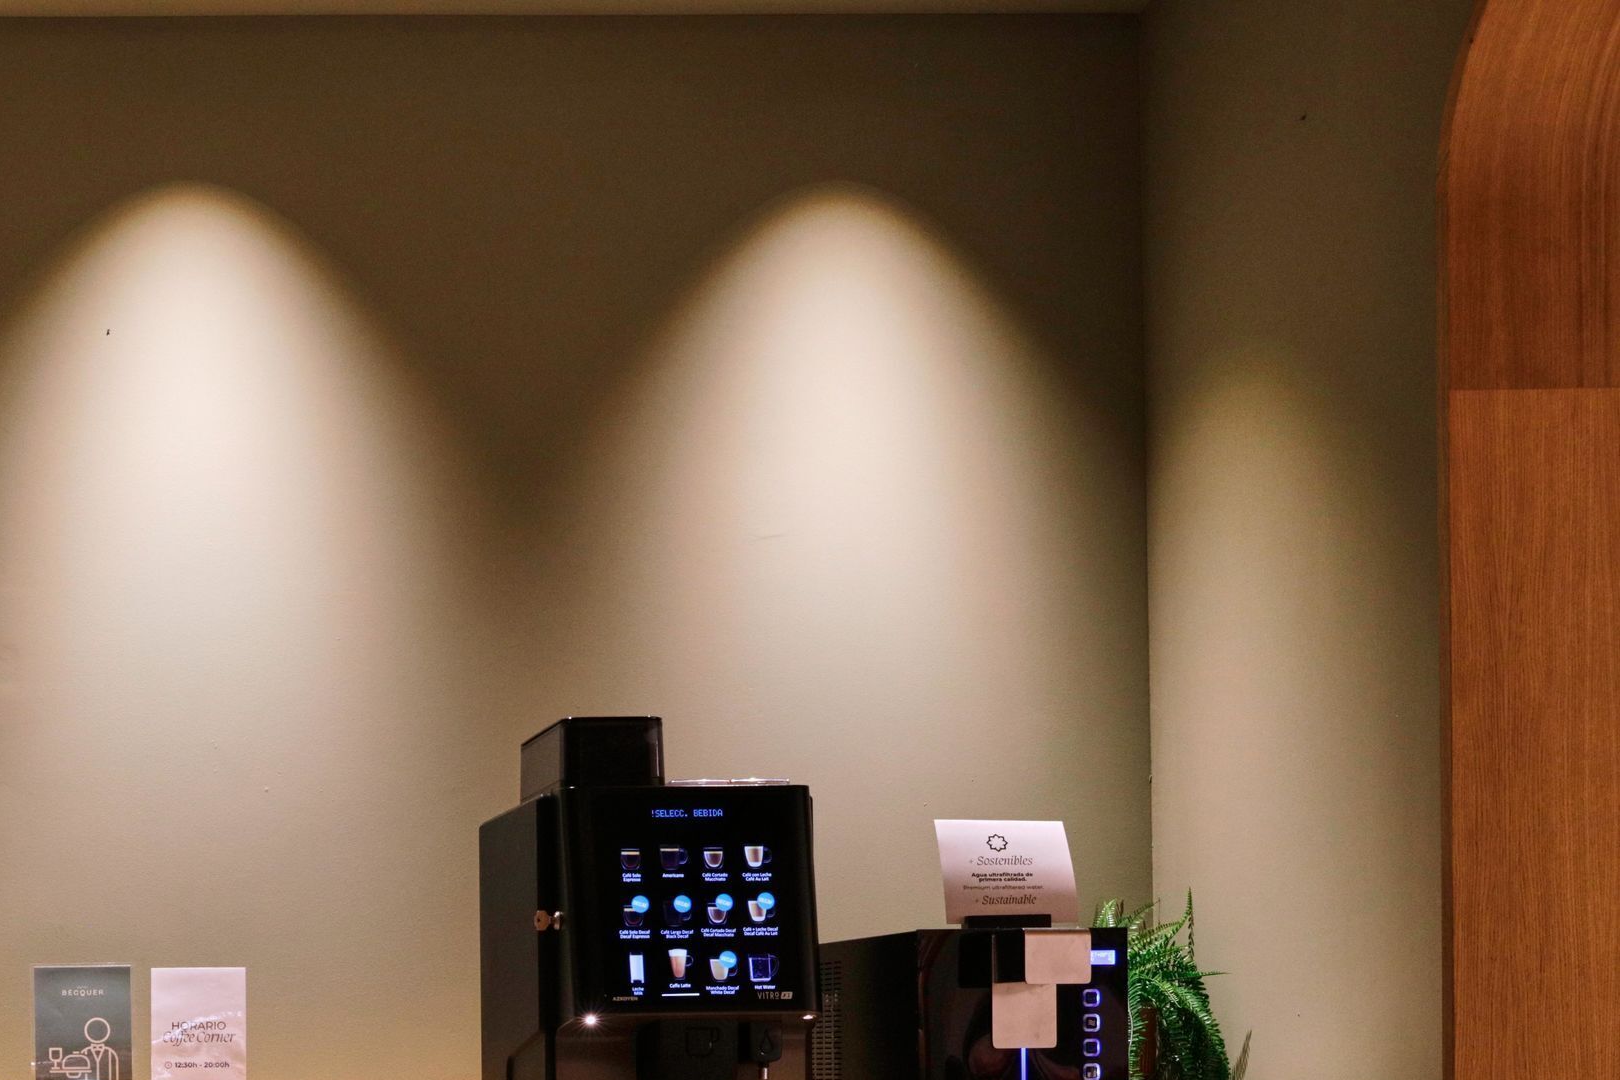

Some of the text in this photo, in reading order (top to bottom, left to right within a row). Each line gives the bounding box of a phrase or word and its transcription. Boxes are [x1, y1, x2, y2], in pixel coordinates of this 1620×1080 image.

[693, 809, 723, 817] BEBIDA
[976, 855, 1033, 866] Sostenibles
[981, 894, 1037, 905] Sustainable
[171, 1021, 226, 1030] HORARIO
[163, 1030, 236, 1046] Coffee Corner
